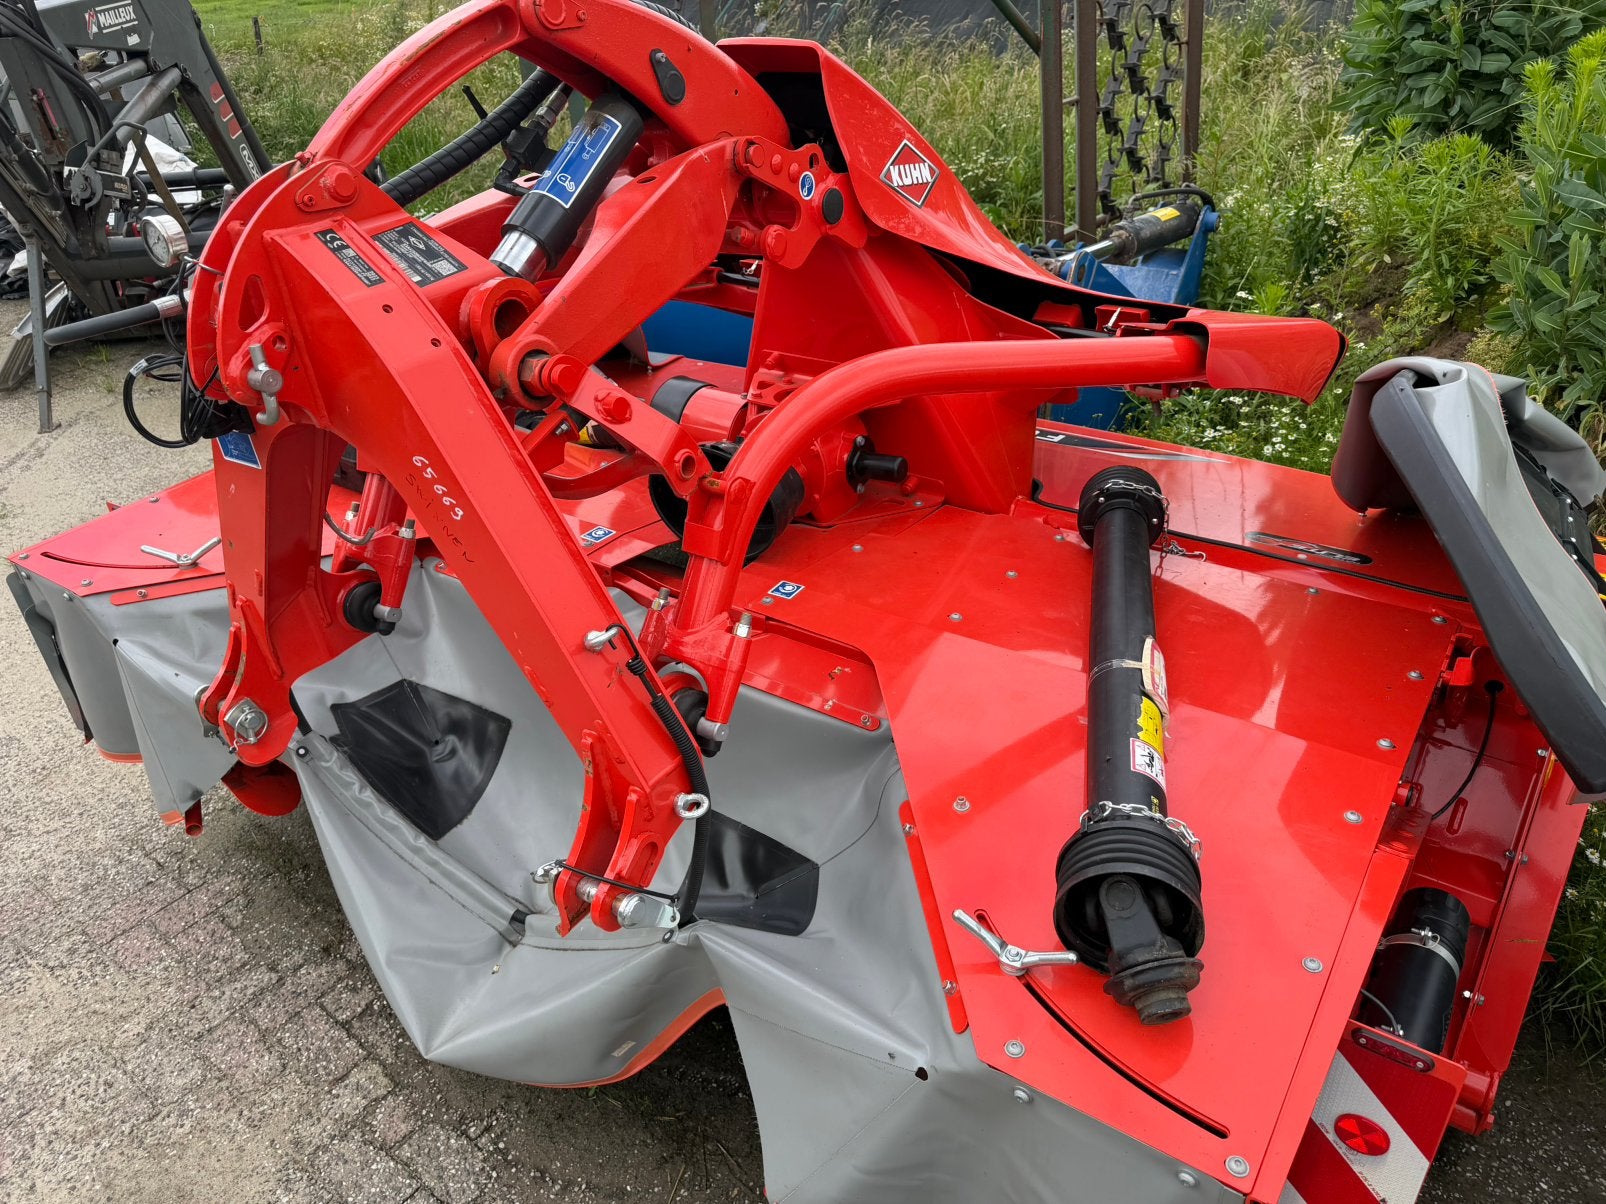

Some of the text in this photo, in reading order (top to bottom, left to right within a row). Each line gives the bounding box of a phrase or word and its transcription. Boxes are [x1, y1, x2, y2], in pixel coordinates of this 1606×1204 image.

[97, 5, 137, 28] MAILLEUX
[889, 162, 933, 187] KUHN
[412, 455, 464, 521] 65669
